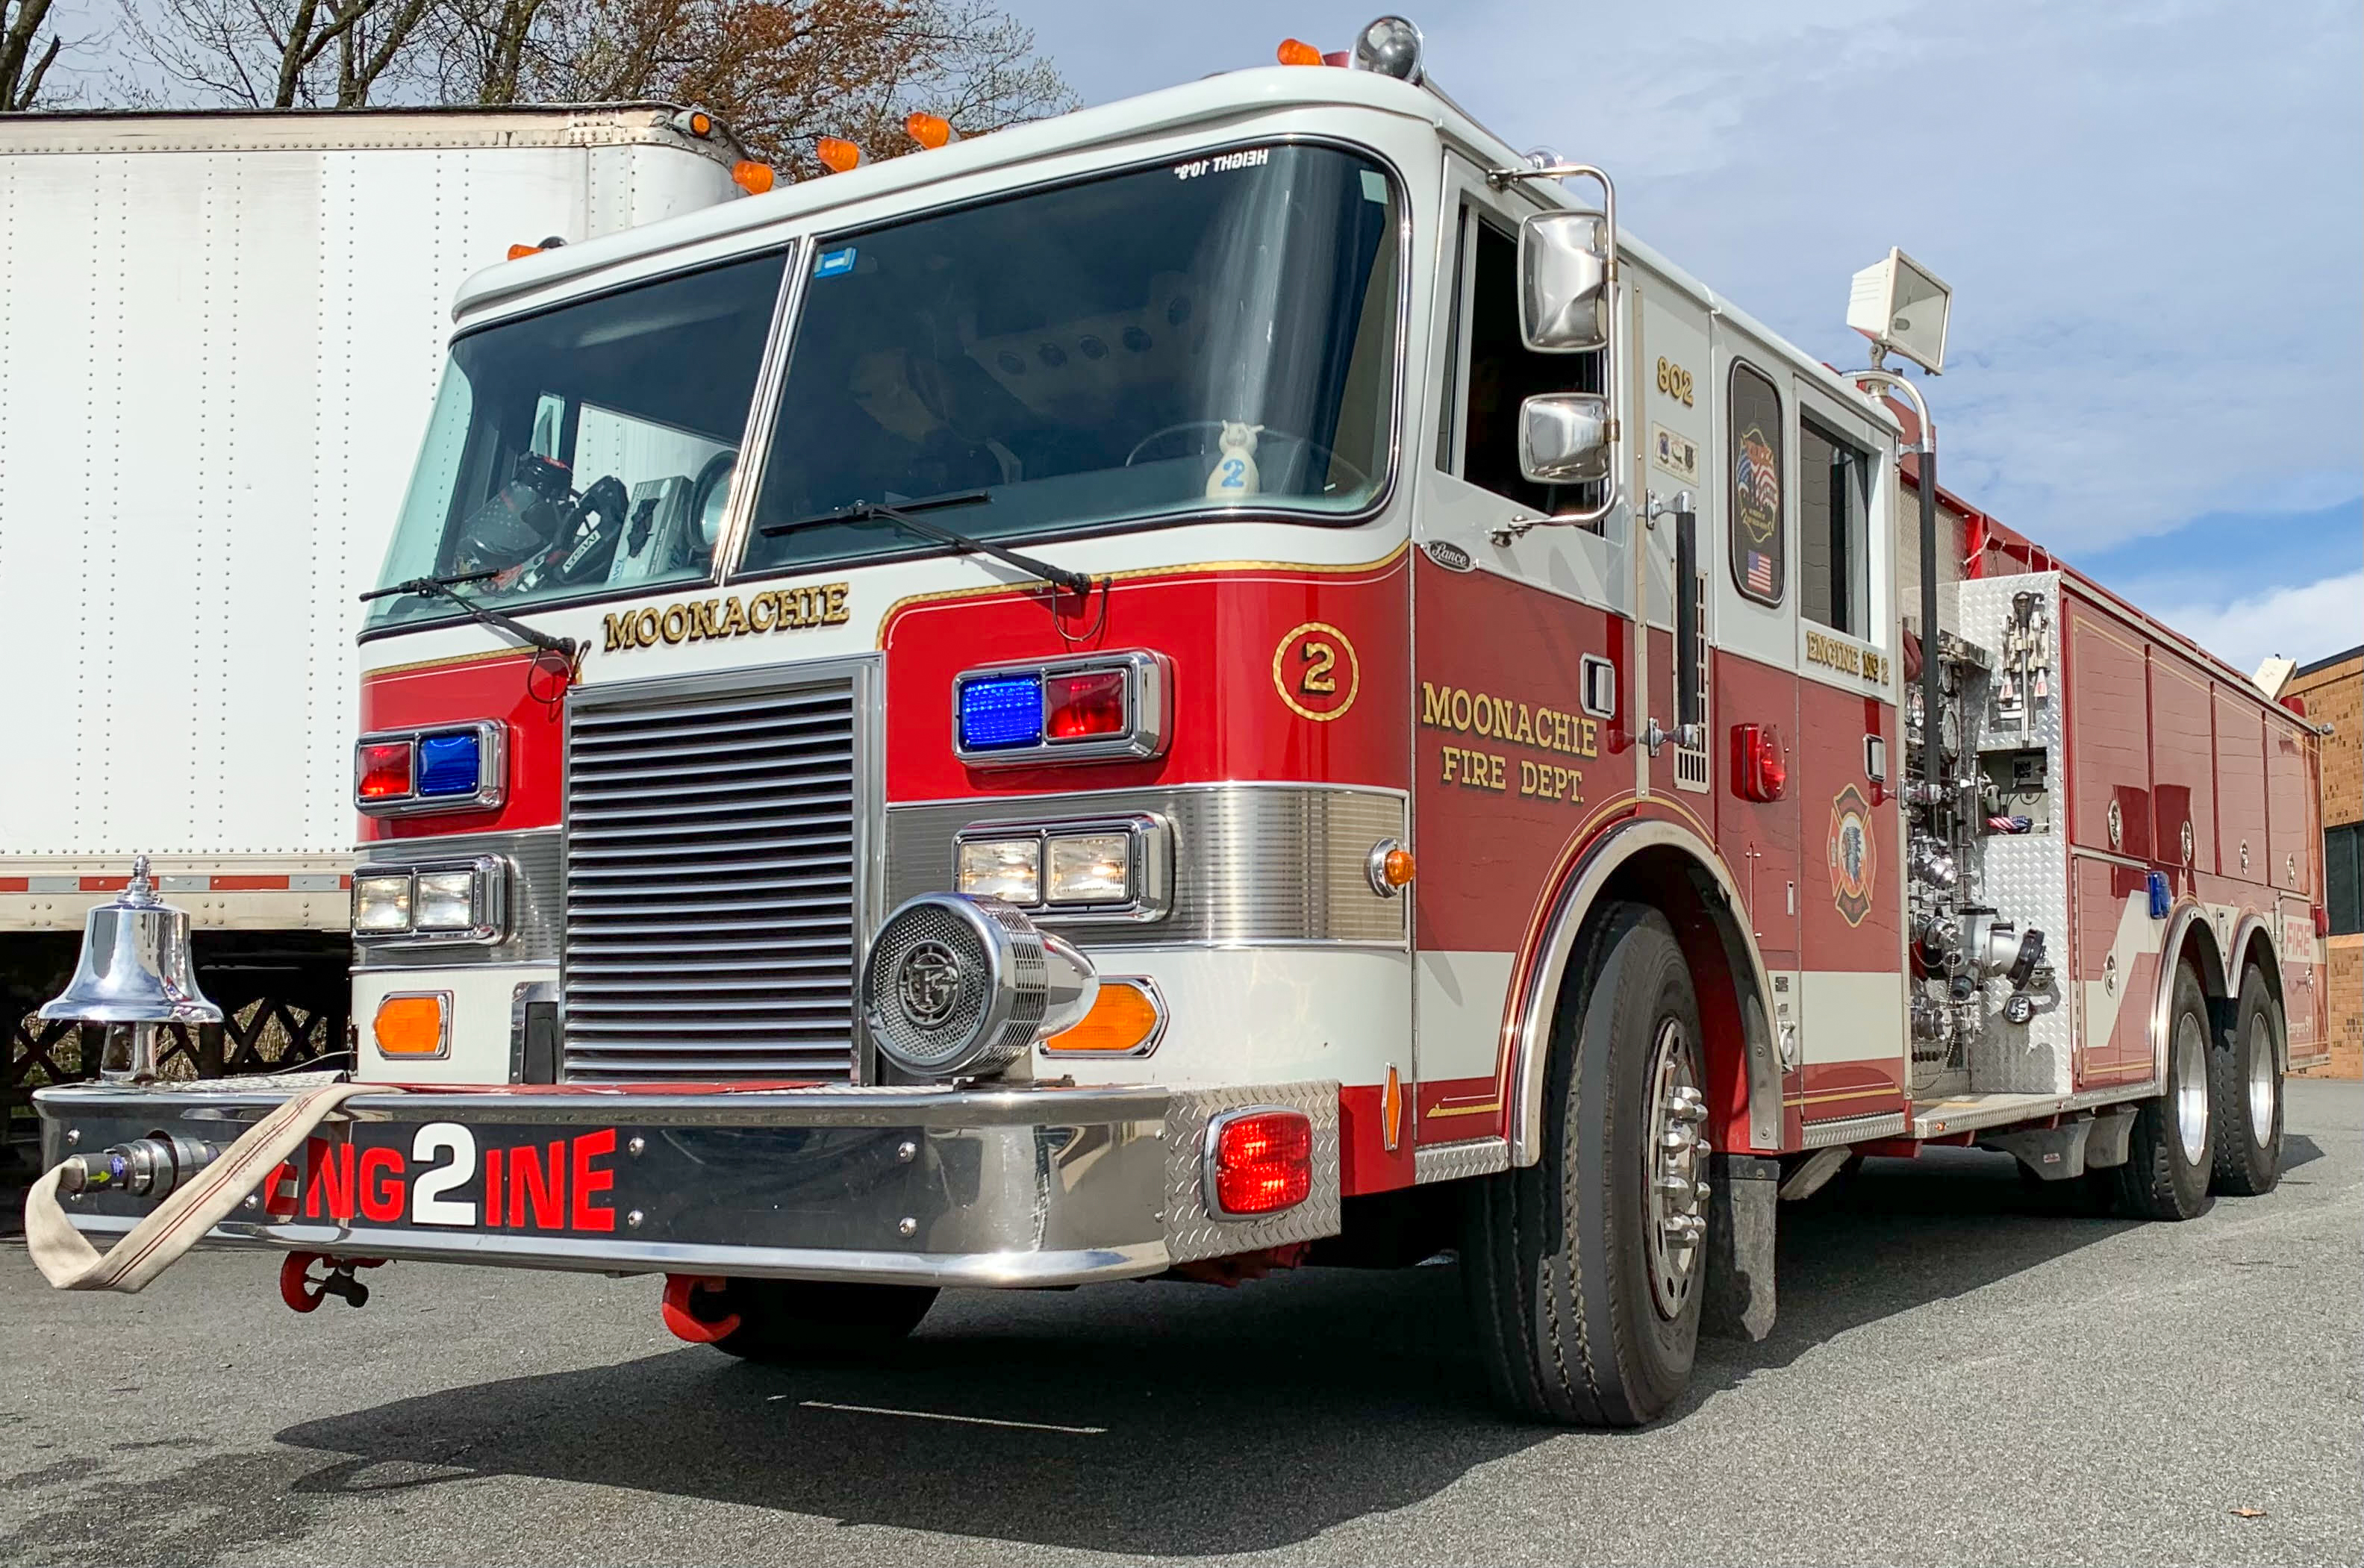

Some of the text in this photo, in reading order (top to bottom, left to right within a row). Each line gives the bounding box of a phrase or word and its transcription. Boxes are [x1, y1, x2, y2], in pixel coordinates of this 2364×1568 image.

[1657, 355, 1694, 408] 802
[1221, 458, 1245, 487] 2
[1432, 543, 1468, 566] Lance
[604, 582, 849, 652] MOONACHIE
[1301, 641, 1336, 695] 2
[1806, 630, 1859, 676] ENGINE
[1880, 658, 1889, 687] 2
[1422, 681, 1598, 758] MOONACHIE
[1442, 746, 1585, 803] FIRE DEPT.
[2286, 922, 2312, 957] FIRE
